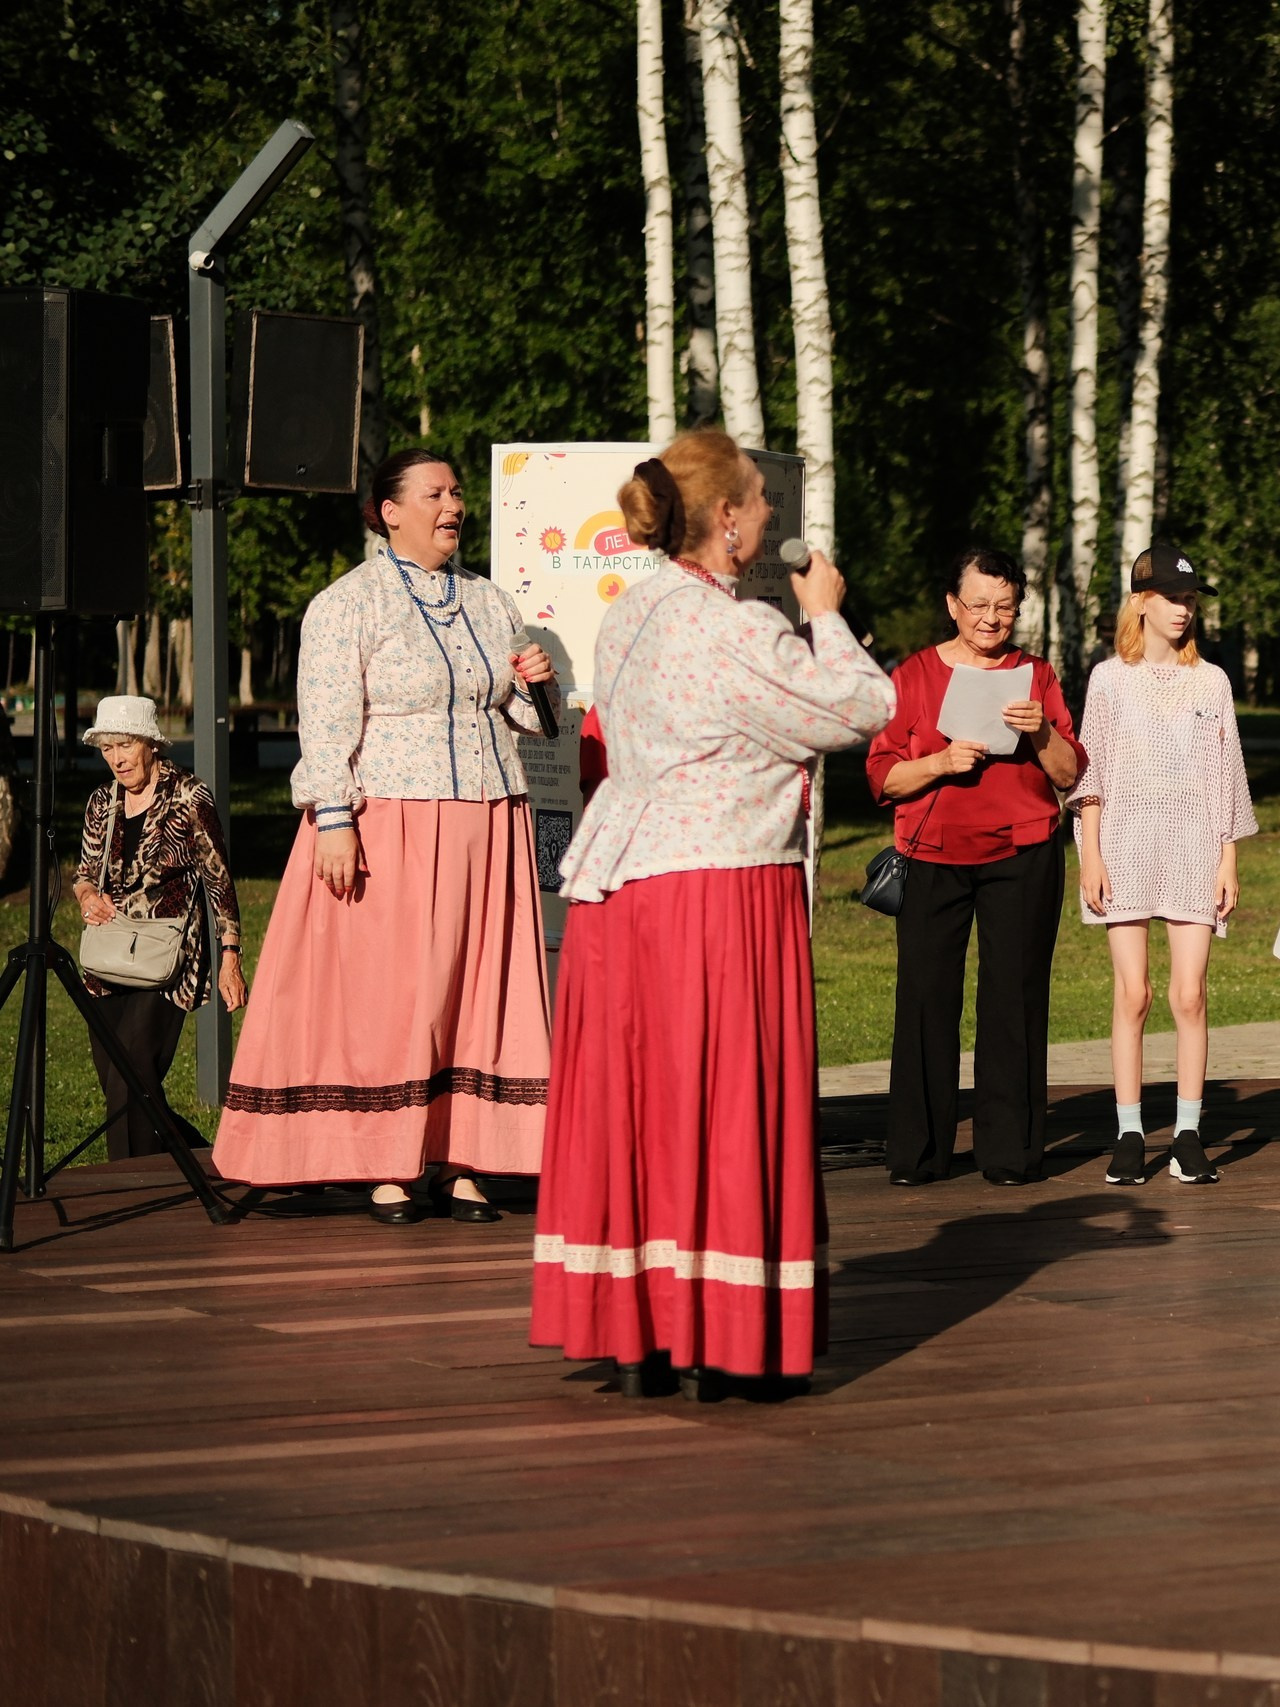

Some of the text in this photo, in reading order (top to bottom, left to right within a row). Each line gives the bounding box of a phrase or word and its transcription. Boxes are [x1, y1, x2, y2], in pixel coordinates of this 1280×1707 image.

[604, 534, 631, 550] ЛЕТ
[552, 556, 661, 570] В ТАТАРСТАН
